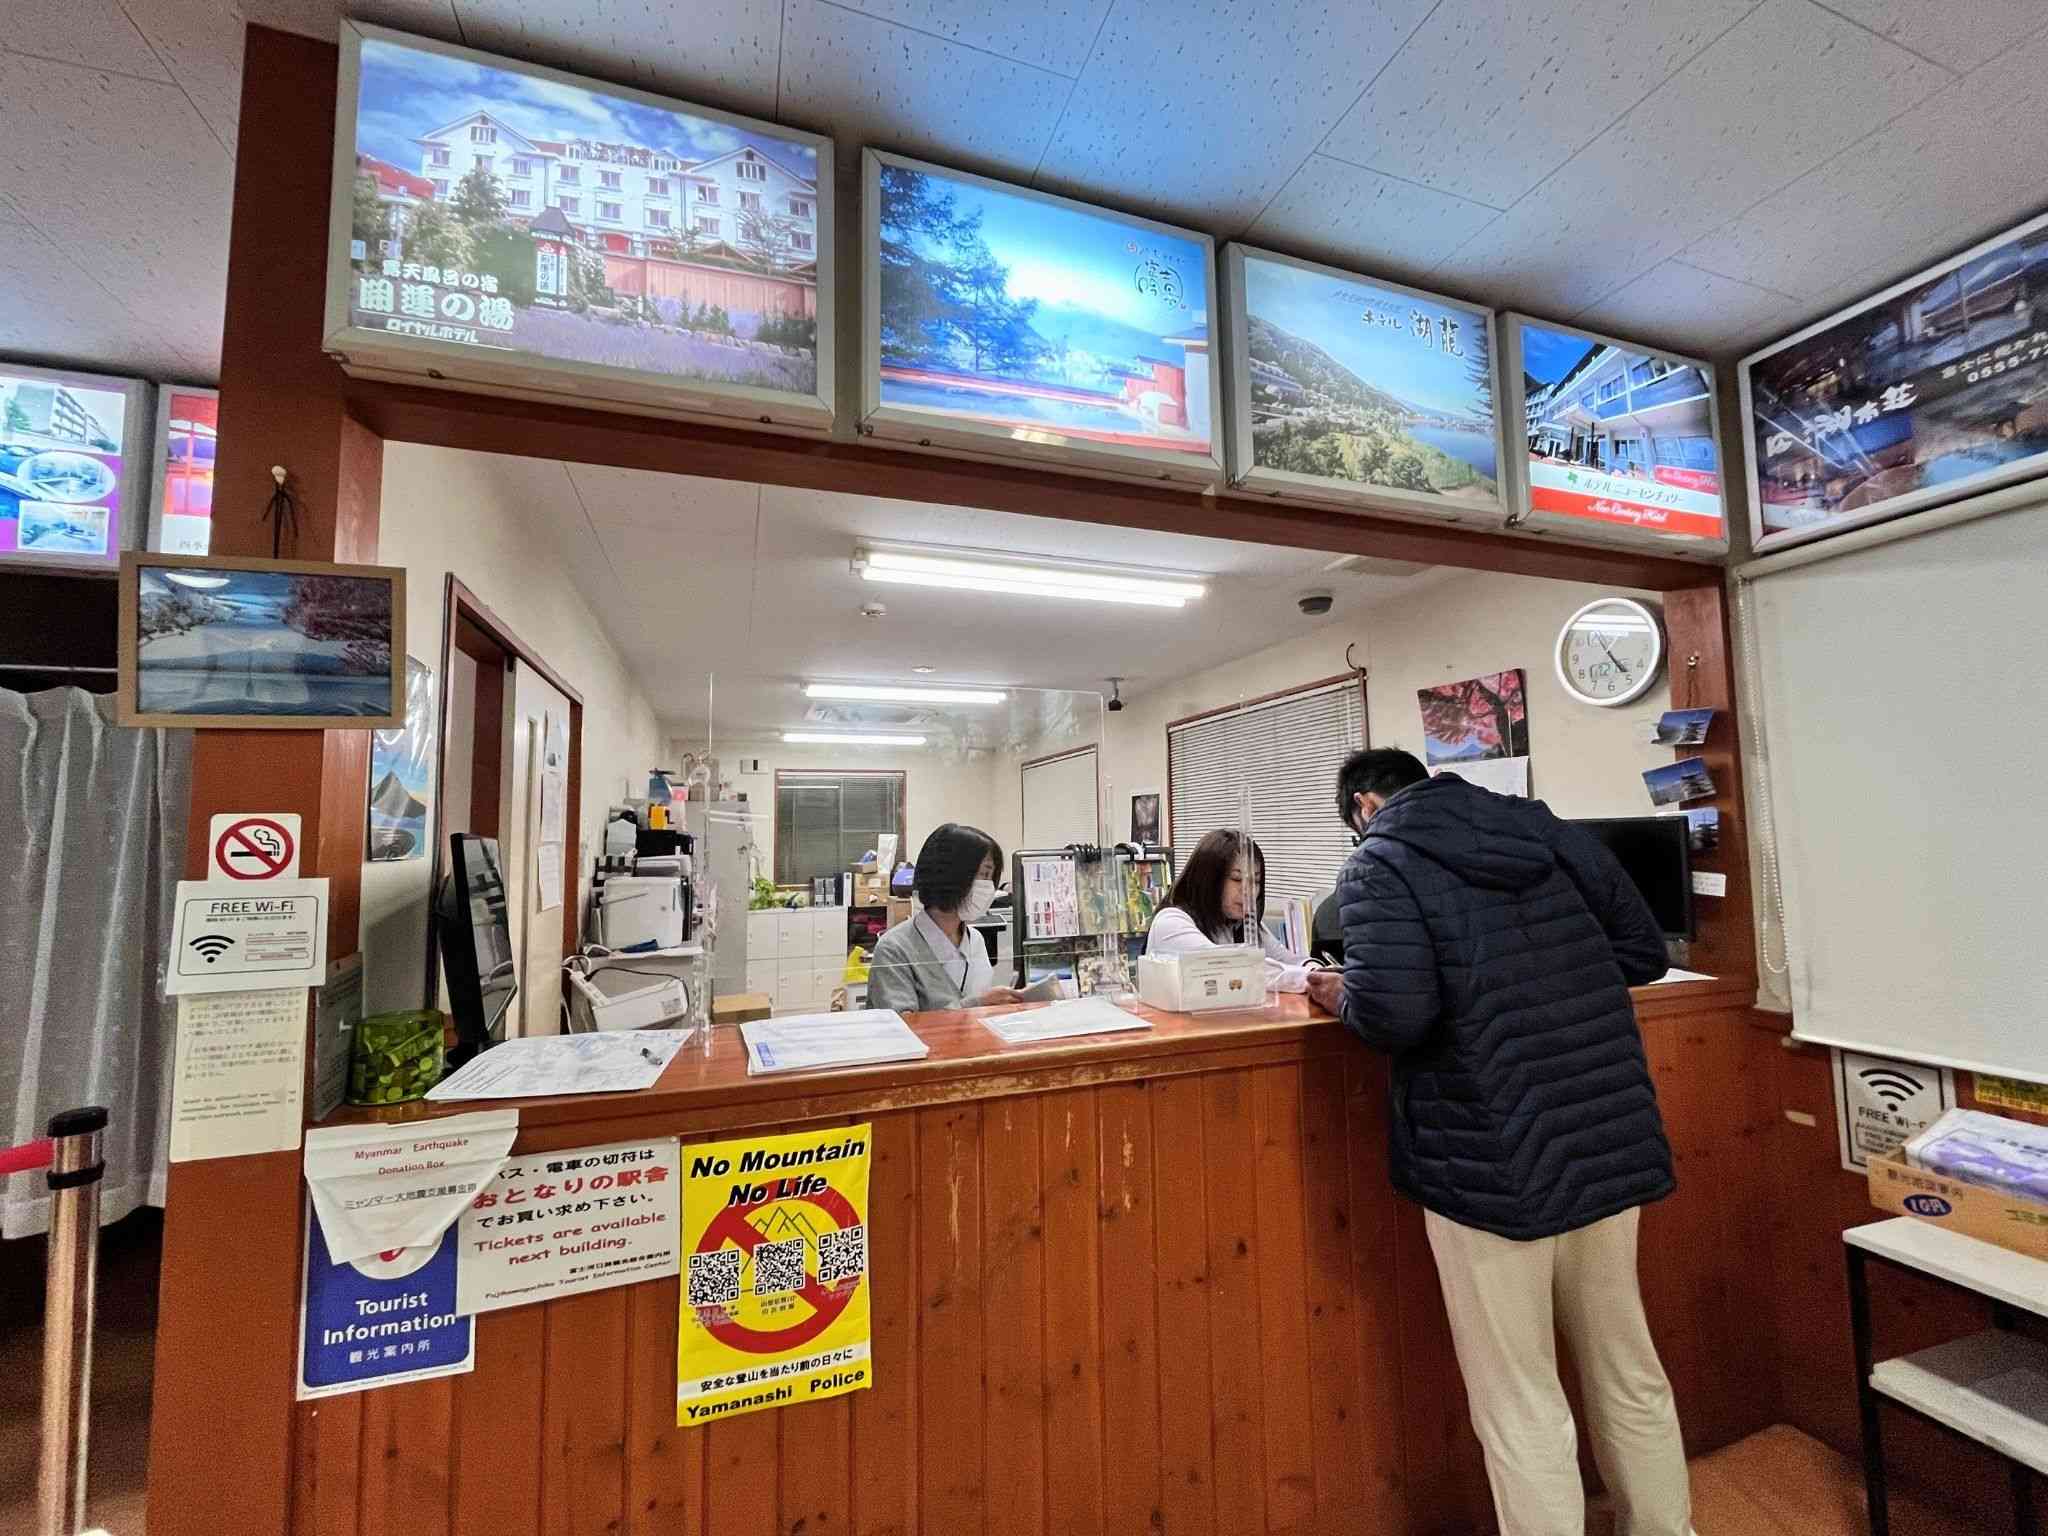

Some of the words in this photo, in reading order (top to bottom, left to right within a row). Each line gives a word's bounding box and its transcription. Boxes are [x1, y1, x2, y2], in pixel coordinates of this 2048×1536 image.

[386, 318, 480, 344] ロイヤルホテル
[1363, 310, 1402, 330] ホテル
[211, 902, 251, 914] FREE
[255, 900, 294, 912] Wi-Fi
[1858, 1106, 1889, 1121] FREE
[354, 1147, 402, 1160] Myanmar
[413, 1137, 469, 1152] Earthquake
[690, 1156, 731, 1179] No
[739, 1139, 866, 1173] Mountain
[379, 1163, 424, 1175] Donation
[426, 1160, 446, 1169] Box
[472, 1166, 669, 1210] おとなりの駅舎
[728, 1182, 768, 1208] No
[775, 1173, 828, 1201] Life
[477, 1193, 653, 1228] でお買い求め下さい。
[474, 1233, 544, 1252] Tickets
[553, 1228, 583, 1240] are
[592, 1213, 666, 1233] available
[509, 1250, 551, 1265] next
[560, 1237, 633, 1257] building.
[355, 1292, 429, 1317] Tourist
[323, 1313, 456, 1346] Information
[349, 1339, 430, 1364] 観光案内所
[700, 1348, 853, 1393] 安全な登山を当たり前の日々に
[687, 1384, 793, 1419] Yamanashi
[810, 1369, 866, 1394] Police
